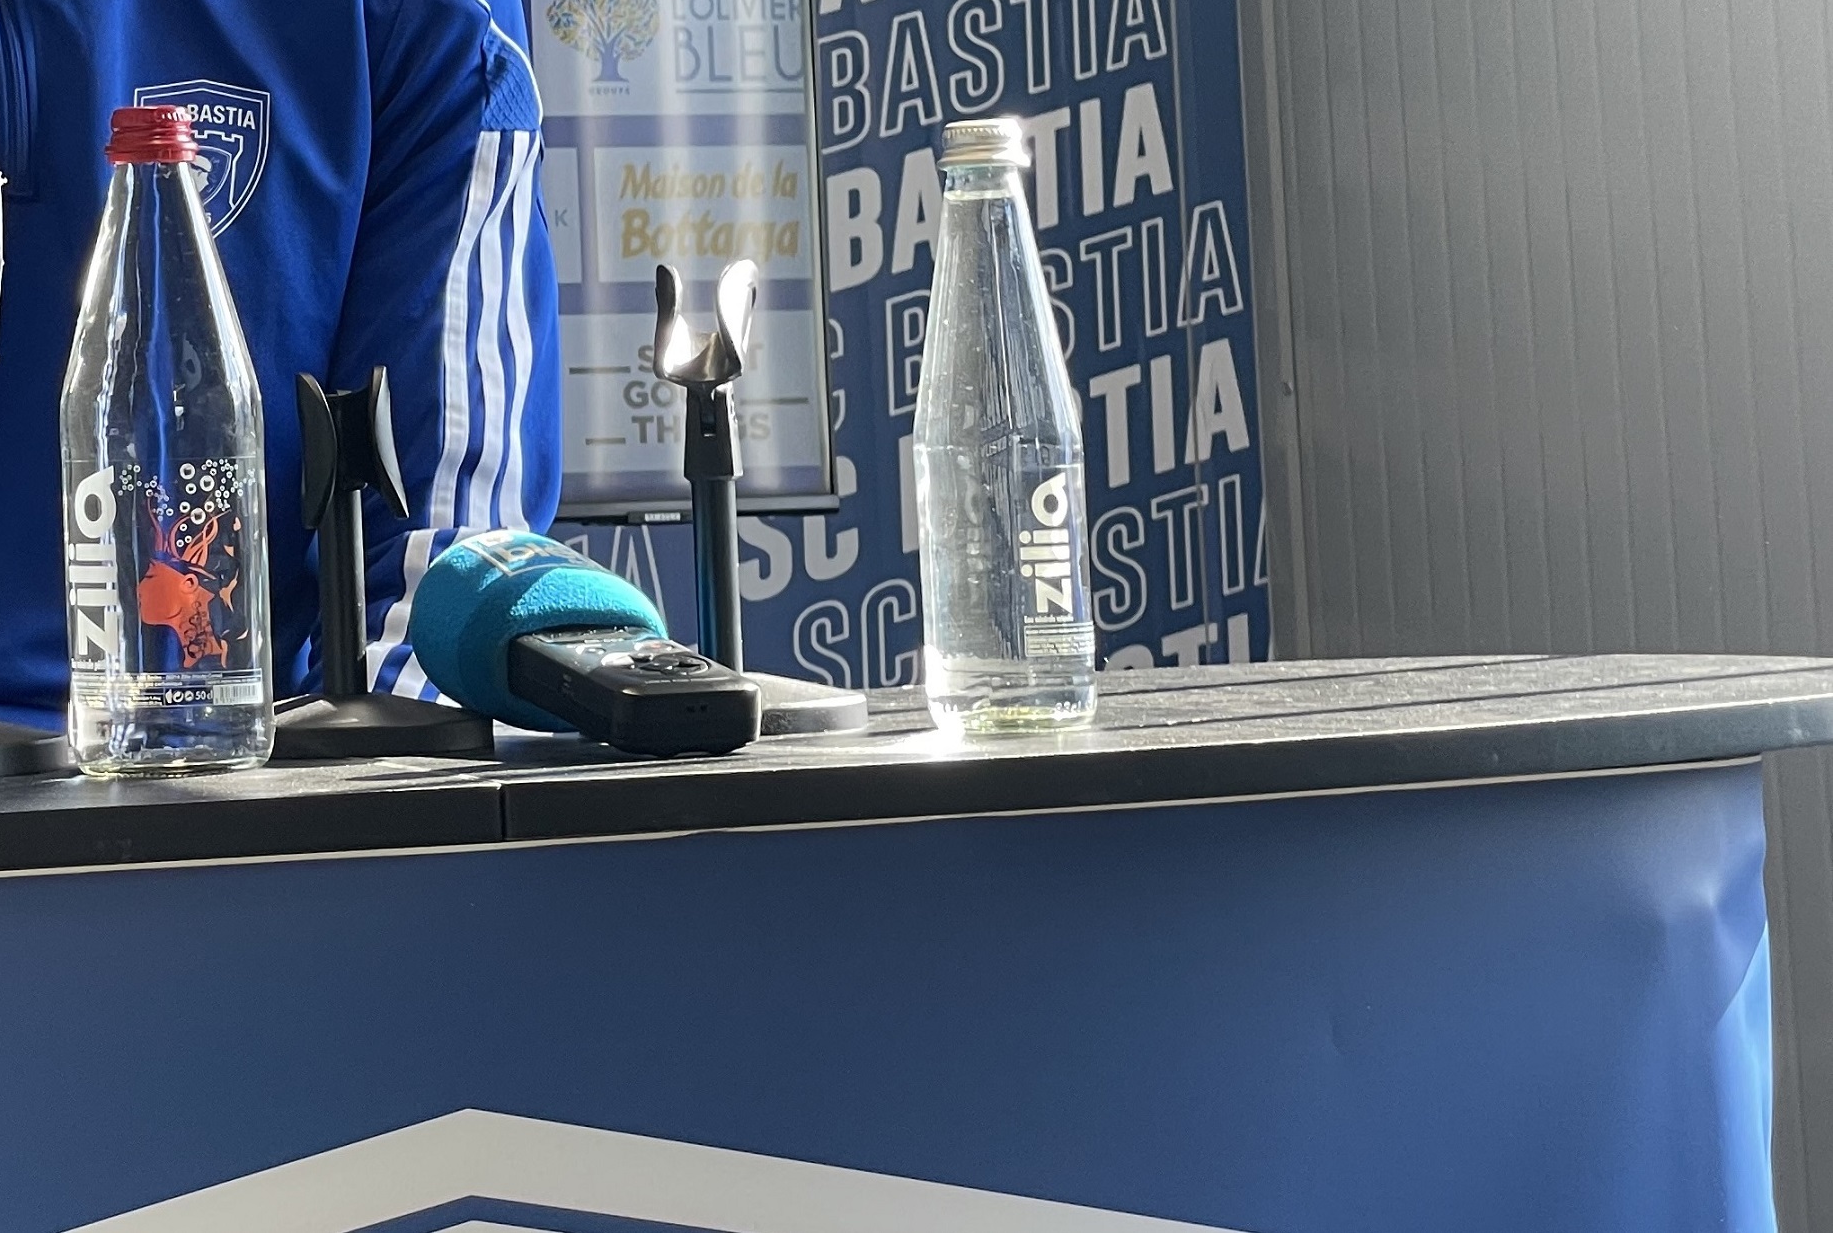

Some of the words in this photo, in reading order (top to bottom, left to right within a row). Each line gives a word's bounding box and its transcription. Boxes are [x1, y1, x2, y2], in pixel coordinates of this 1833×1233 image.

[620, 163, 725, 201] Maison
[733, 160, 767, 200] de
[772, 158, 798, 200] la
[621, 212, 801, 263] Bottarga
[826, 82, 1174, 293] BATIA
[69, 465, 119, 670] zilia
[1019, 472, 1074, 614] zilia
